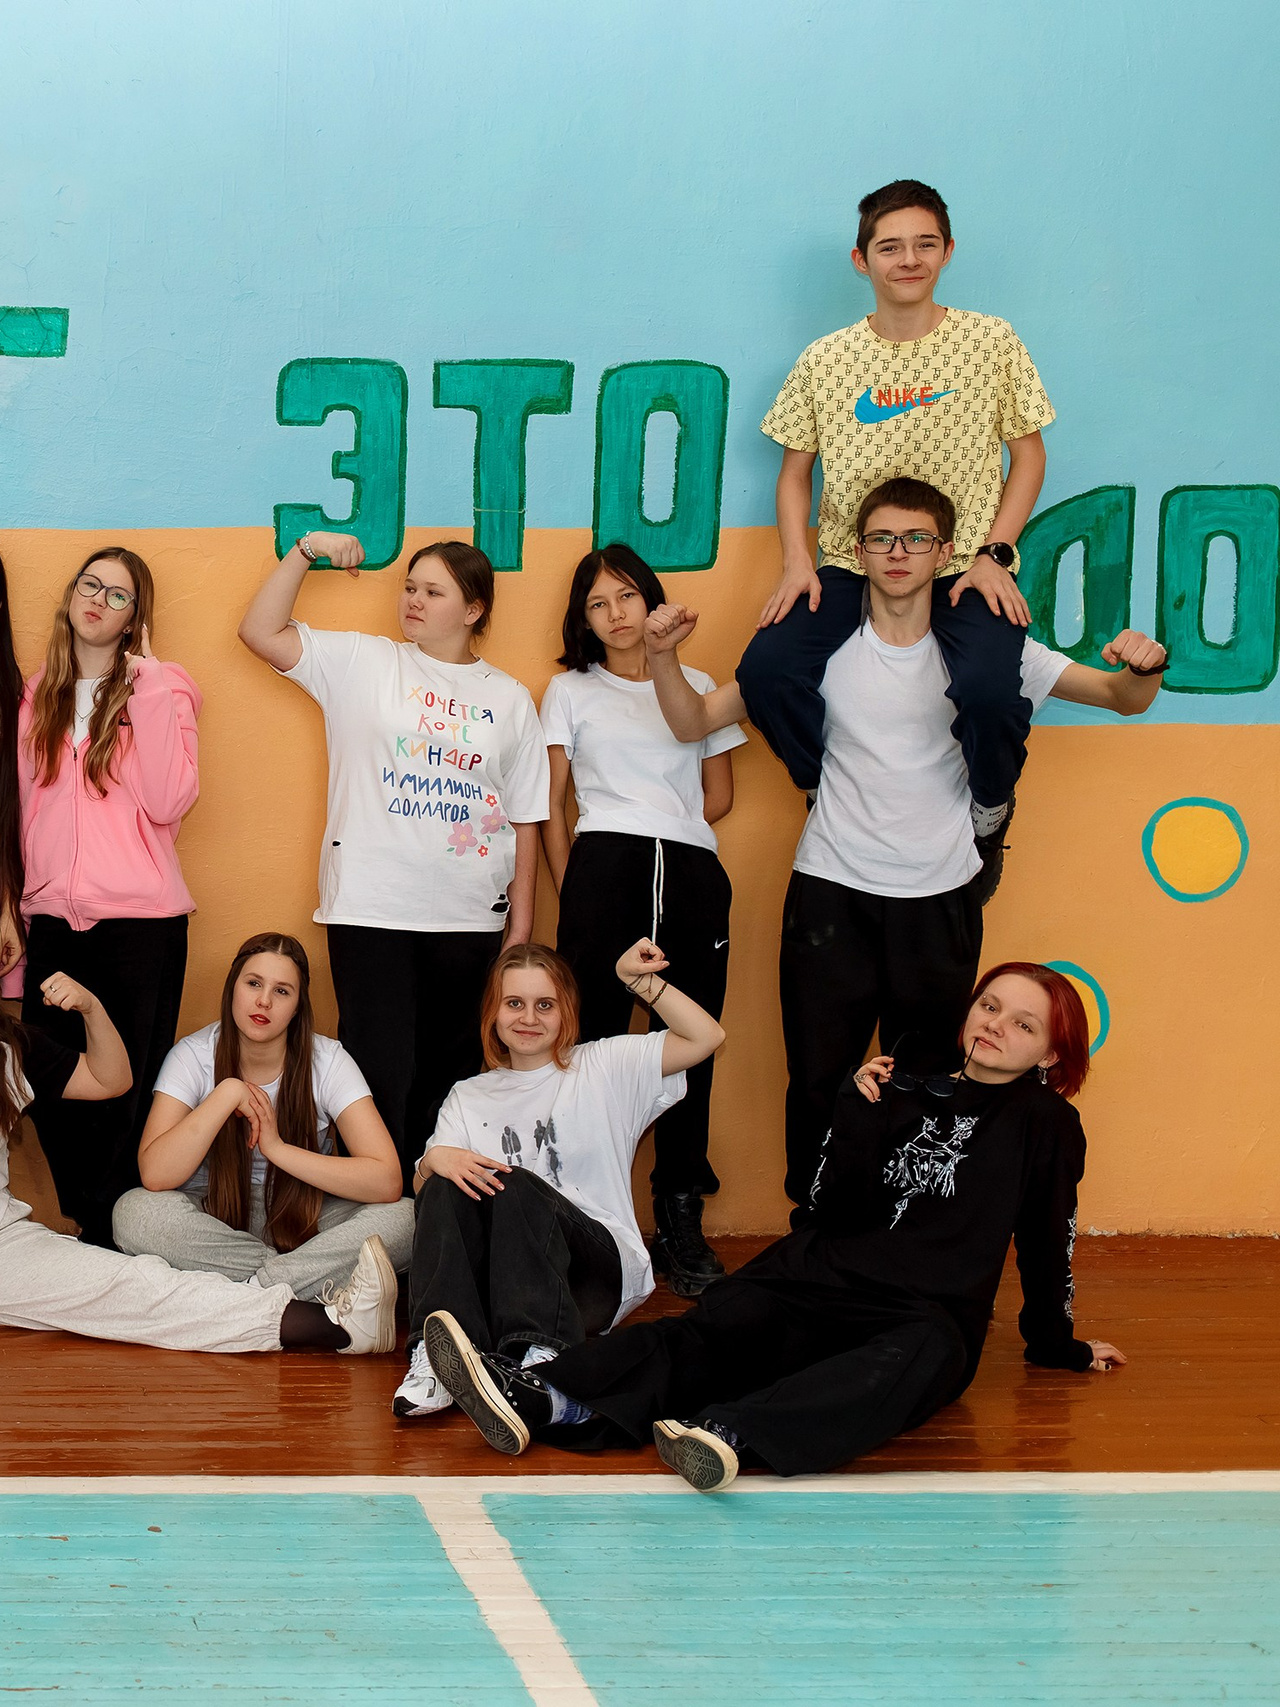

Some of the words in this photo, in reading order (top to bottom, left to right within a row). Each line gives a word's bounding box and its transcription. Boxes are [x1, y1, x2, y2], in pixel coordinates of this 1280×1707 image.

[877, 387, 934, 408] NIKE
[273, 356, 730, 573] ЭТО
[407, 686, 494, 724] ХОЧЕТСЯ
[395, 736, 482, 770] КИНДЕР
[383, 767, 395, 788] И
[400, 773, 483, 801] МИЛЛИОН
[388, 797, 470, 823] ДОЛЛАРОВ
